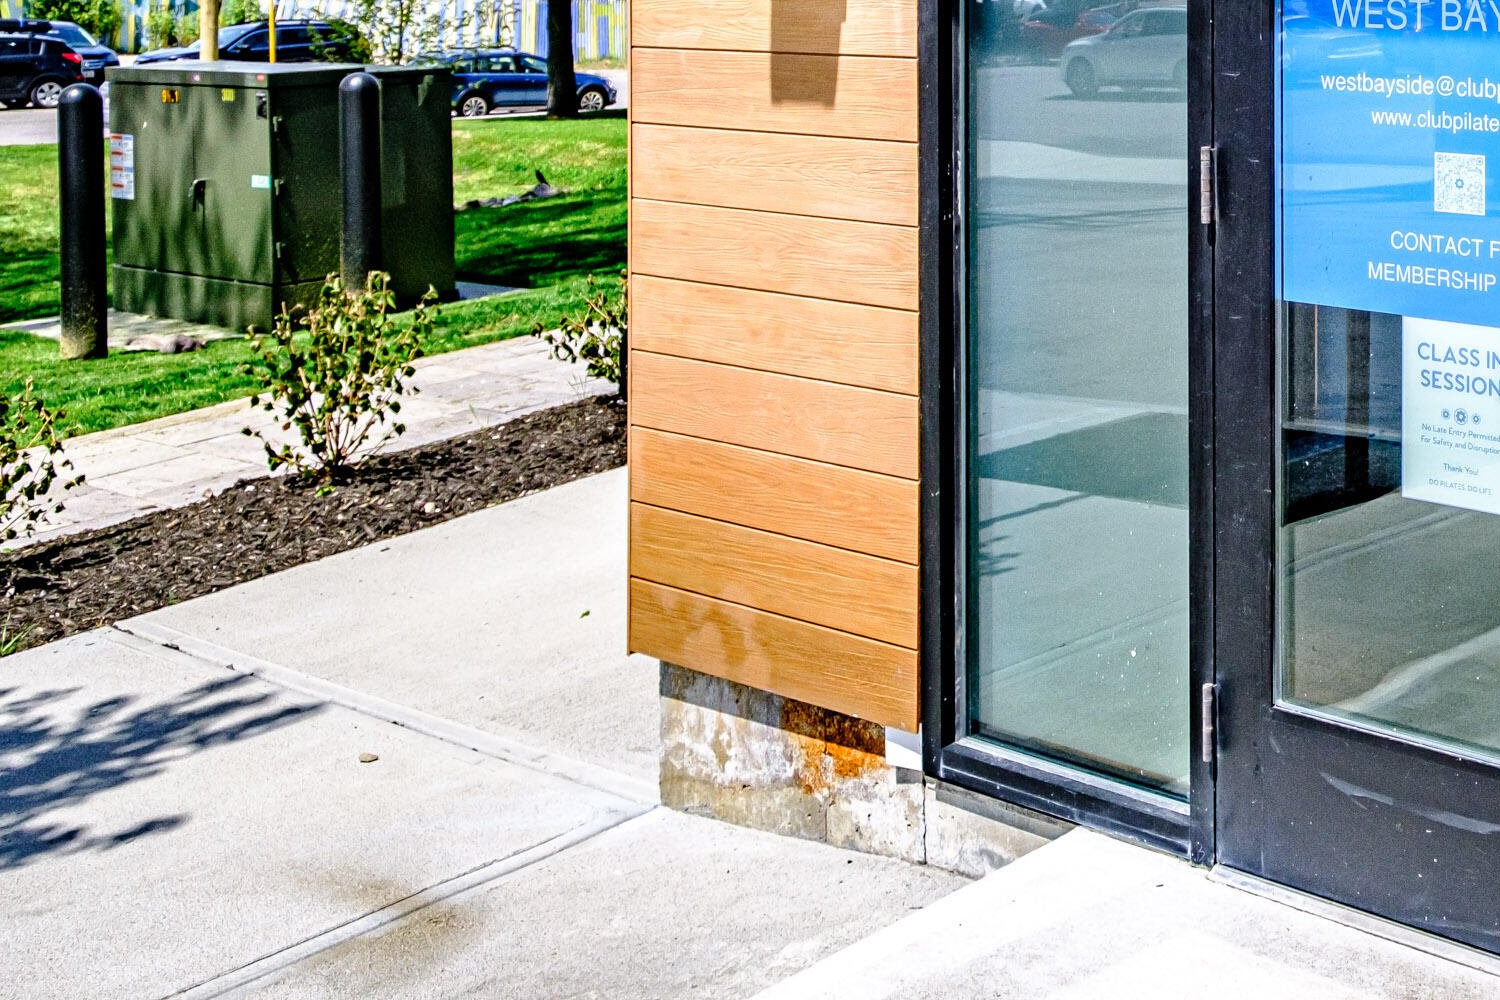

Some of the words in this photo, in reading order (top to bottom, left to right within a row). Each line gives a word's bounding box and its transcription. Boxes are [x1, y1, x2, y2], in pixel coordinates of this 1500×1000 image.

[1390, 230, 1484, 257] CONTACT
[1367, 261, 1497, 292] MEMBERSHIP
[1417, 342, 1481, 368] CLASS
[1422, 423, 1432, 432] No
[1432, 425, 1447, 434] Late
[1448, 427, 1467, 438] Entry
[1421, 435, 1431, 443] For
[1432, 437, 1453, 448] Safety
[1443, 462, 1463, 473] Thank
[1428, 478, 1439, 486] DO
[1467, 484, 1478, 492] DO
